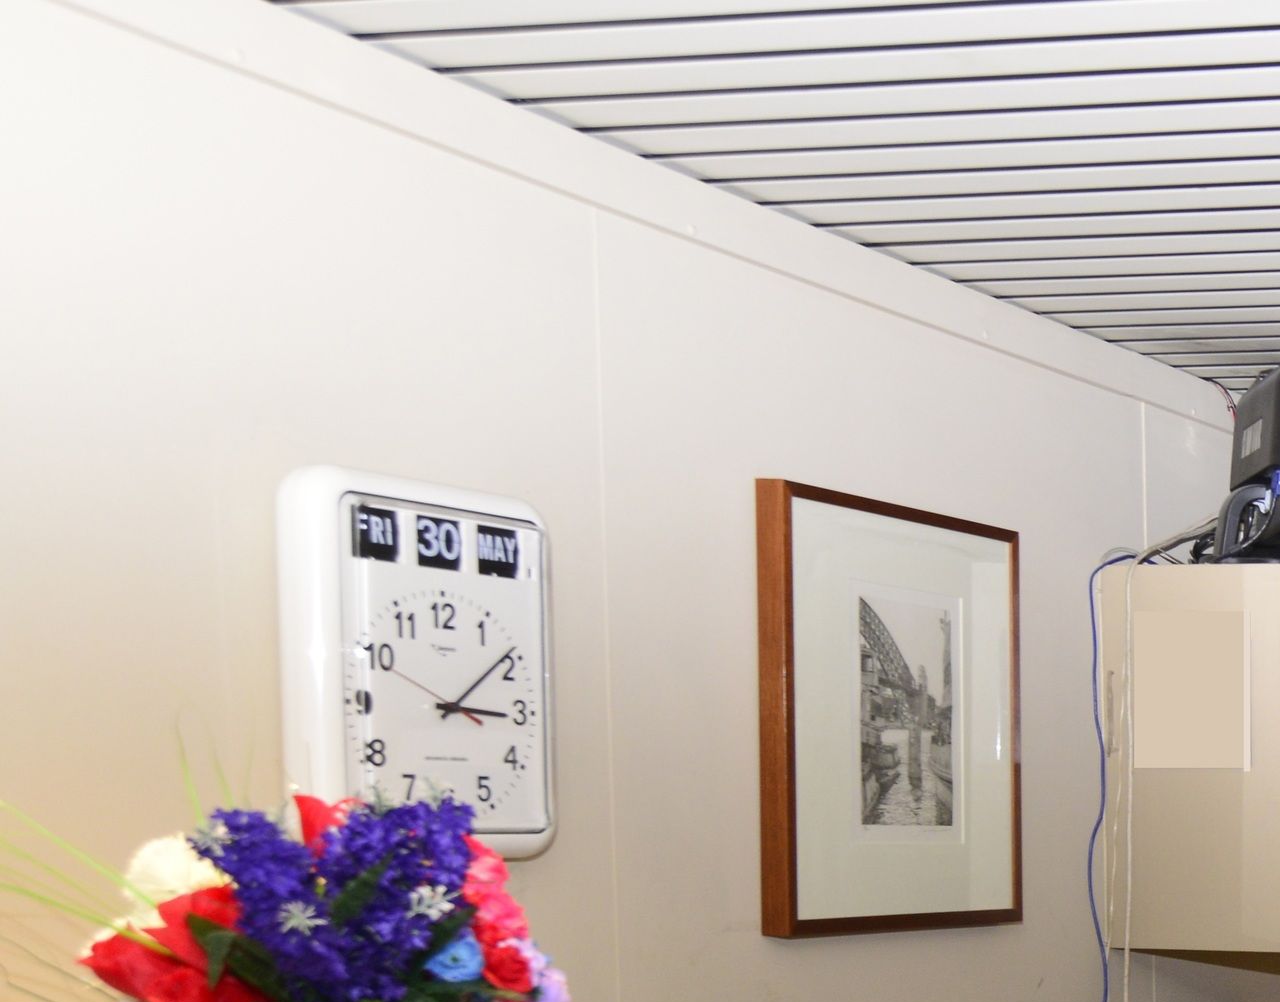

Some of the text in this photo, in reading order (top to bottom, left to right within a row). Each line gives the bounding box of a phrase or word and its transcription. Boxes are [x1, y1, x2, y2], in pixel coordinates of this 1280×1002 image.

[358, 512, 516, 563] FRI 30 MAY
[395, 611, 415, 640] 11
[431, 602, 456, 630] 12
[478, 620, 486, 646] 1
[363, 643, 394, 671] 10
[499, 654, 516, 681] 2
[356, 690, 373, 715] 9
[512, 700, 527, 725] 3
[366, 739, 386, 766] 8
[503, 745, 519, 771] 4
[402, 774, 416, 801] 7
[477, 776, 492, 802] 5
